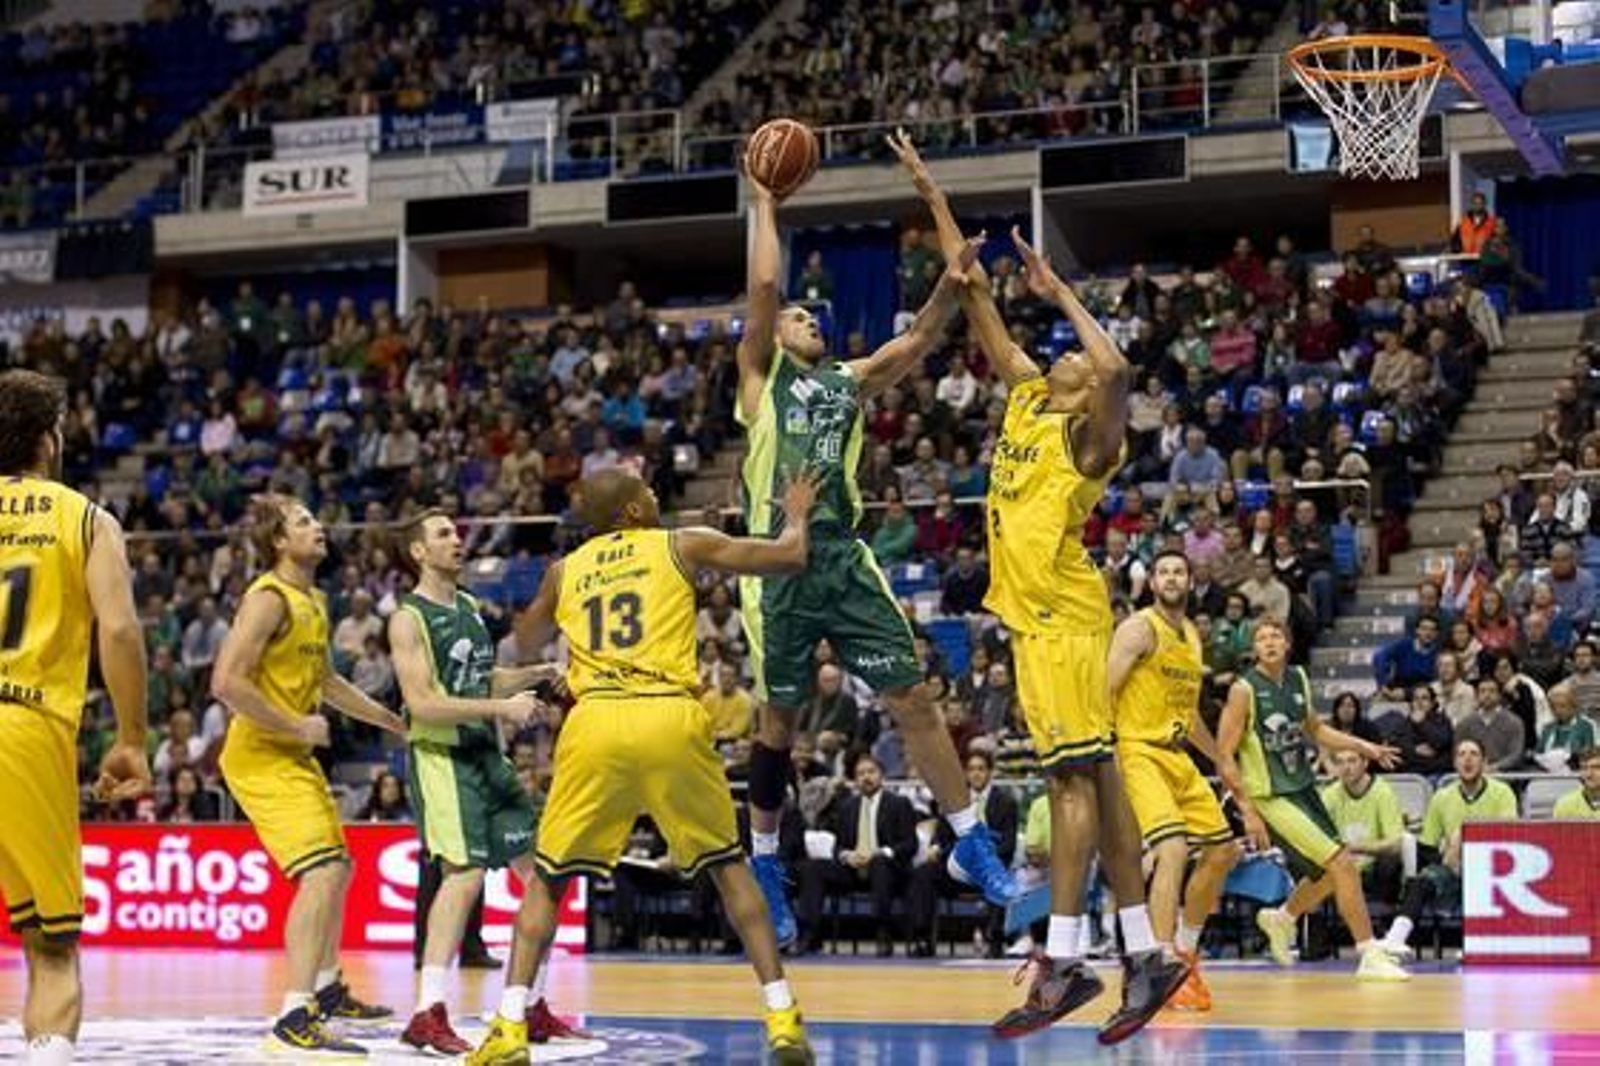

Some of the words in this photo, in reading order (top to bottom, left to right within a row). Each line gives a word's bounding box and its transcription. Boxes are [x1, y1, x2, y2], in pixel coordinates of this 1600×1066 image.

[258, 165, 351, 197] SUR
[581, 591, 644, 652] 13
[115, 834, 271, 894] años
[1463, 842, 1569, 917] R
[115, 897, 268, 942] contigo
